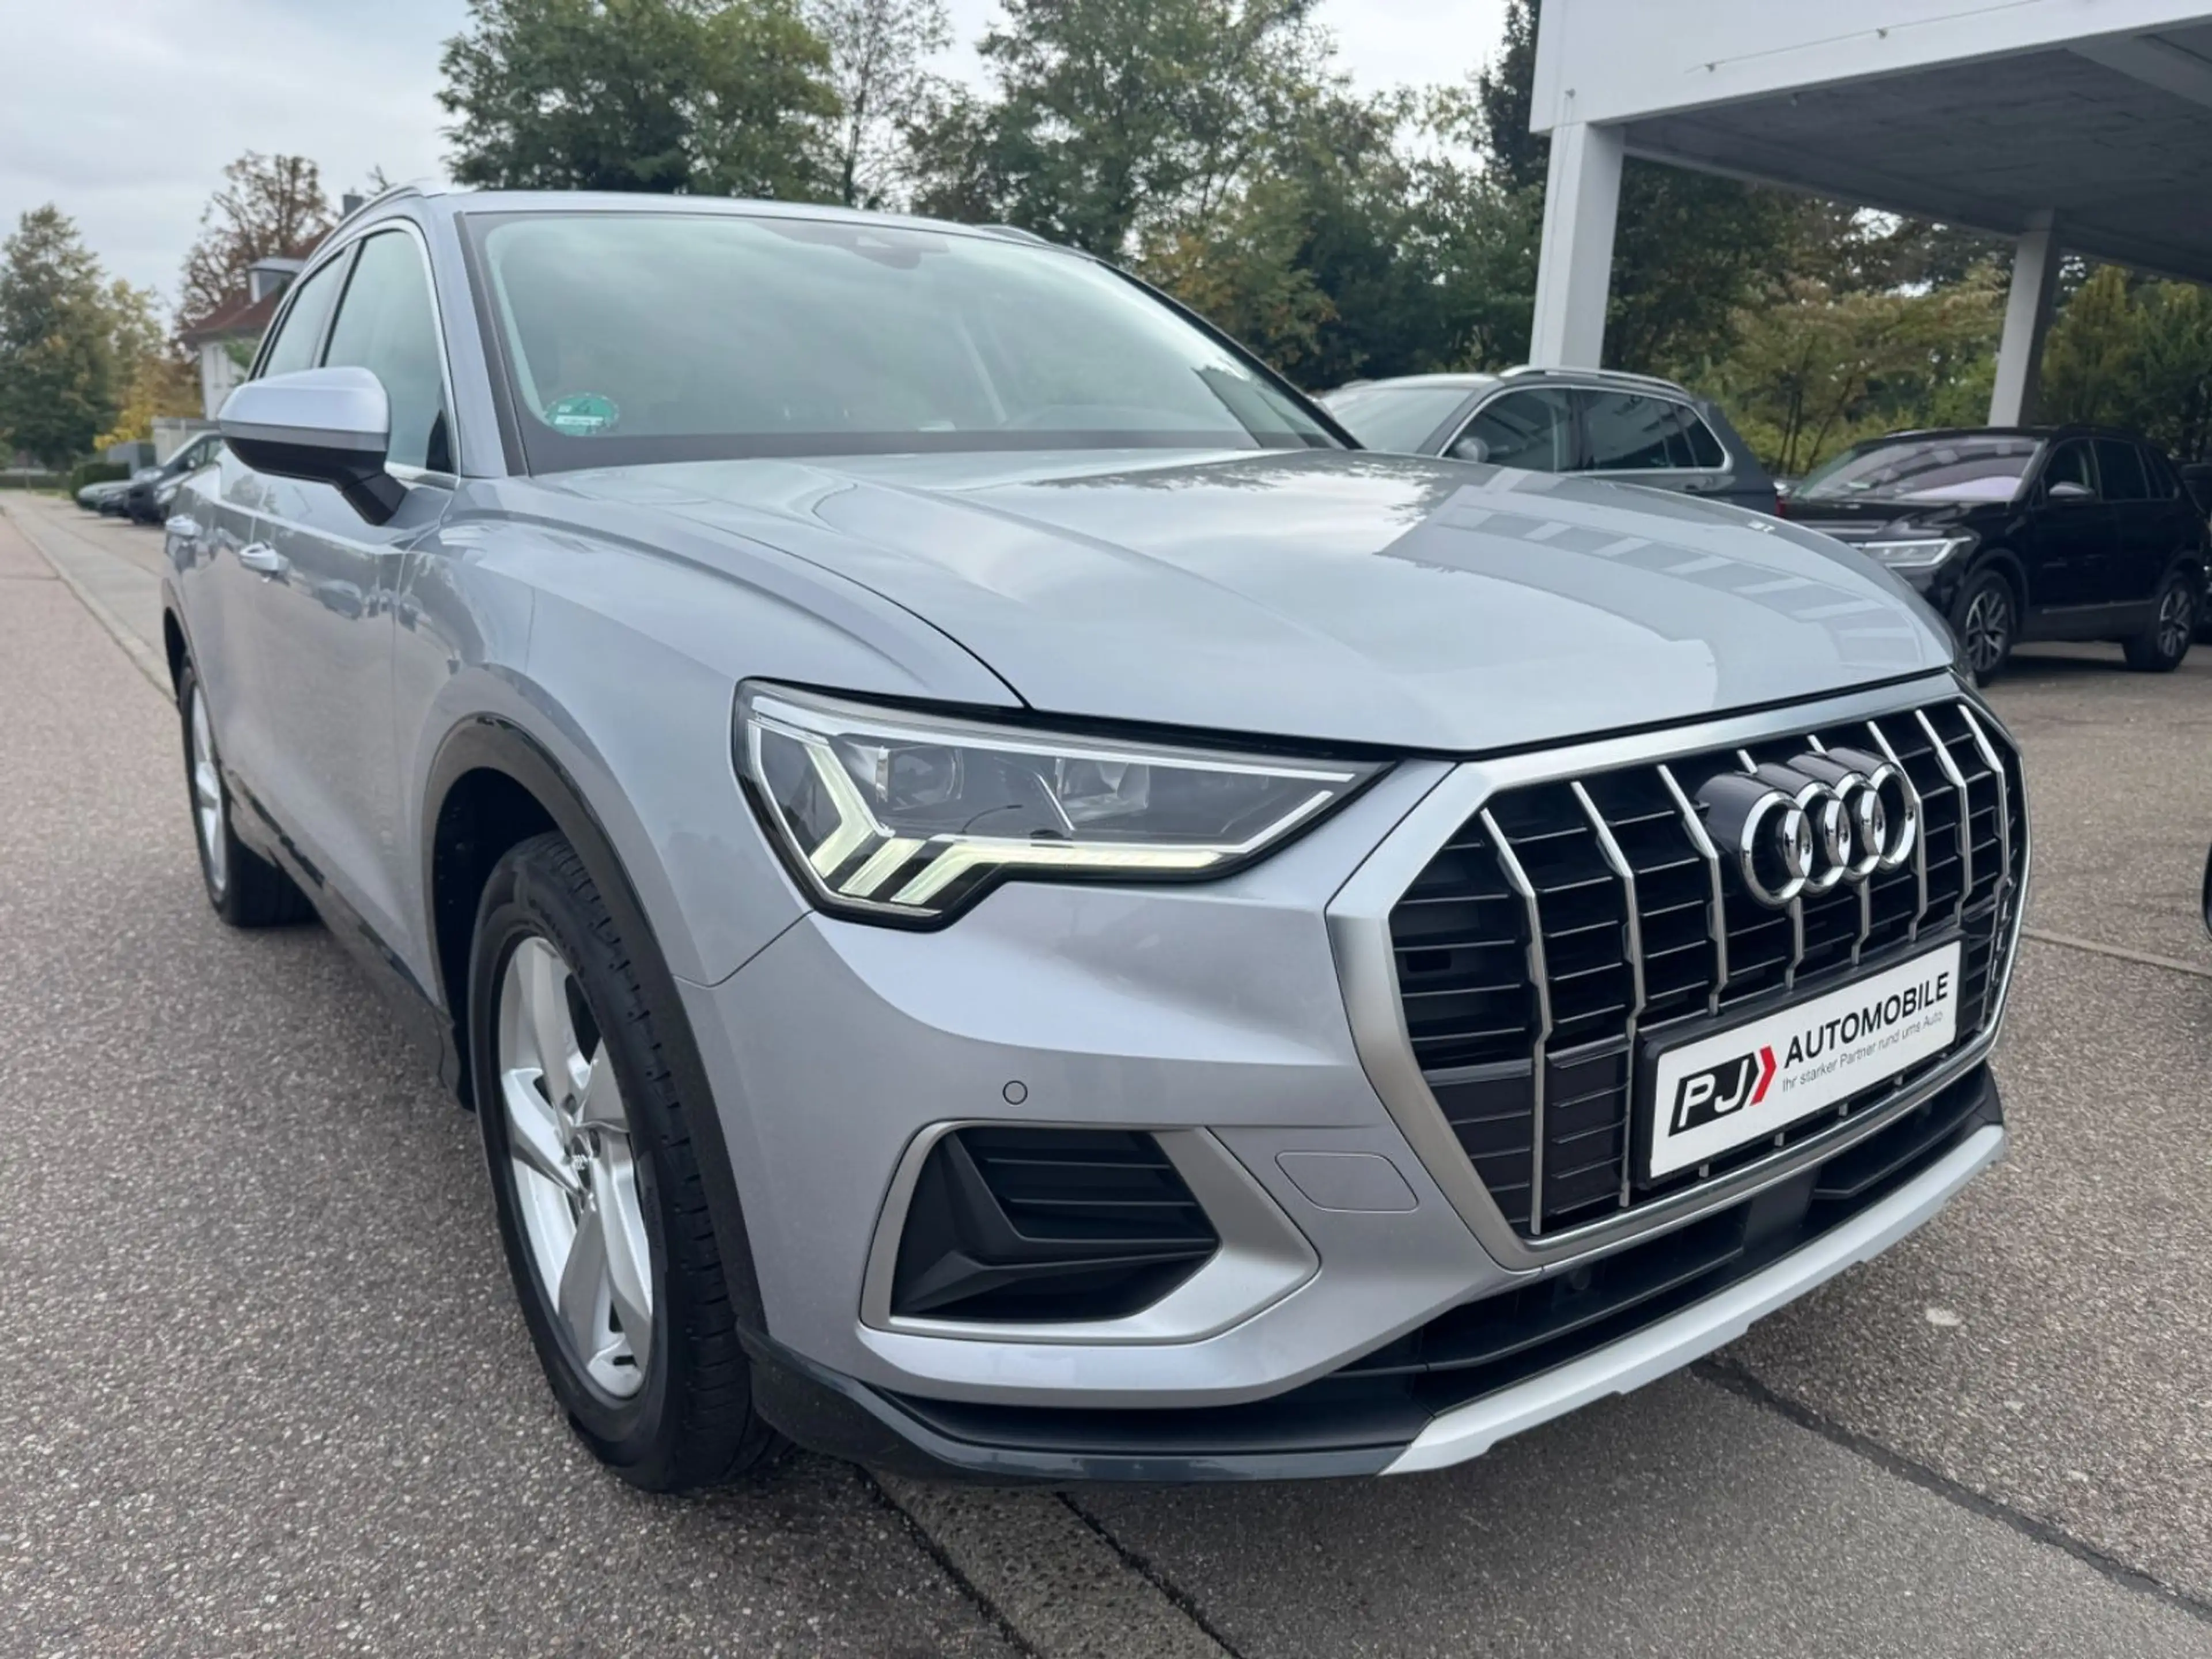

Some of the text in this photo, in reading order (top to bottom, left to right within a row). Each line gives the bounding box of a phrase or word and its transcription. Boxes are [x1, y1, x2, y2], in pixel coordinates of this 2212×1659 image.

[1677, 971, 1949, 1128] PJ AUTOMOBILE
[1782, 1010, 1944, 1093] Ihr starker Partner rund ums Auto
